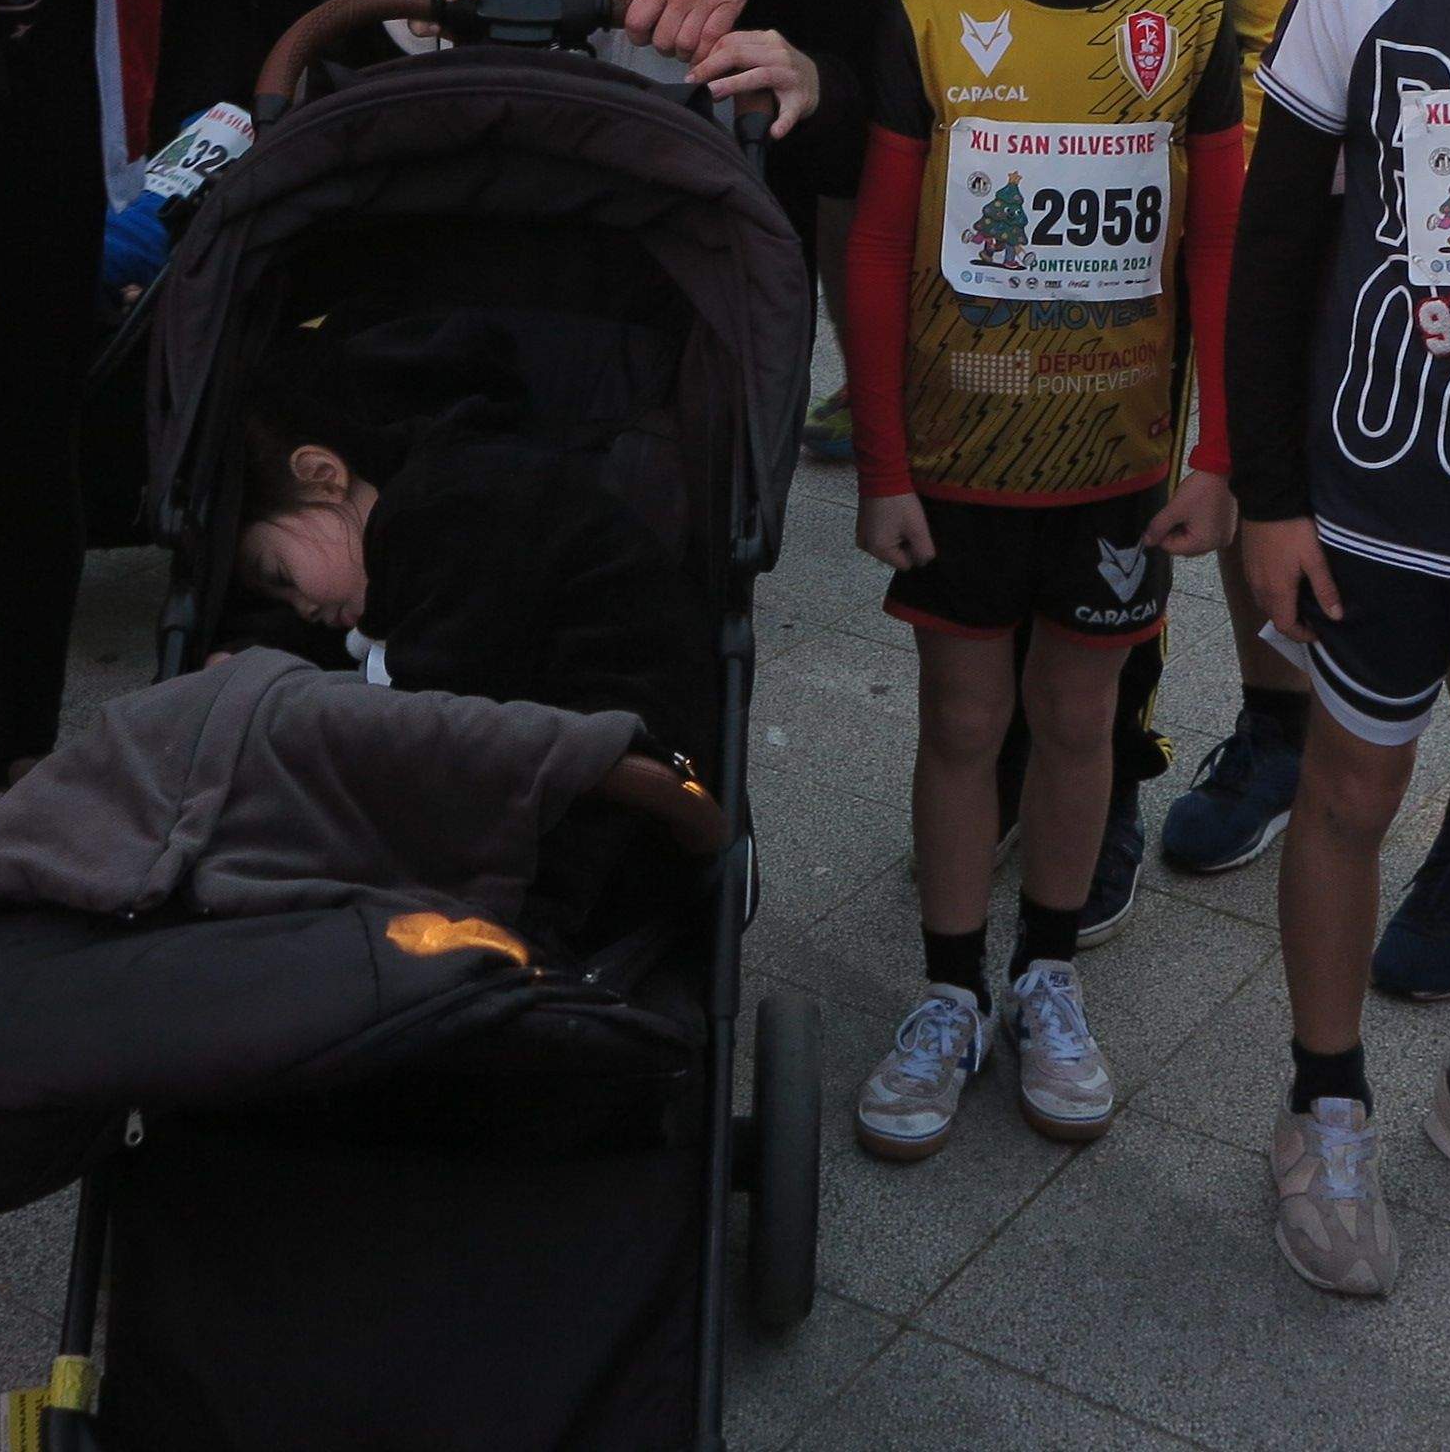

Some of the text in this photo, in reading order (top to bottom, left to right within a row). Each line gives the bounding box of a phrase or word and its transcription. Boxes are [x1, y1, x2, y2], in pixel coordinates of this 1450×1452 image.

[946, 85, 1029, 103] CARACAL
[971, 130, 1156, 156] XLI SAN SILVESTRE
[1030, 184, 1163, 247] 2958
[1029, 257, 1119, 273] PONTEVEDRA
[1037, 342, 1157, 375] DEPUTACIÓN
